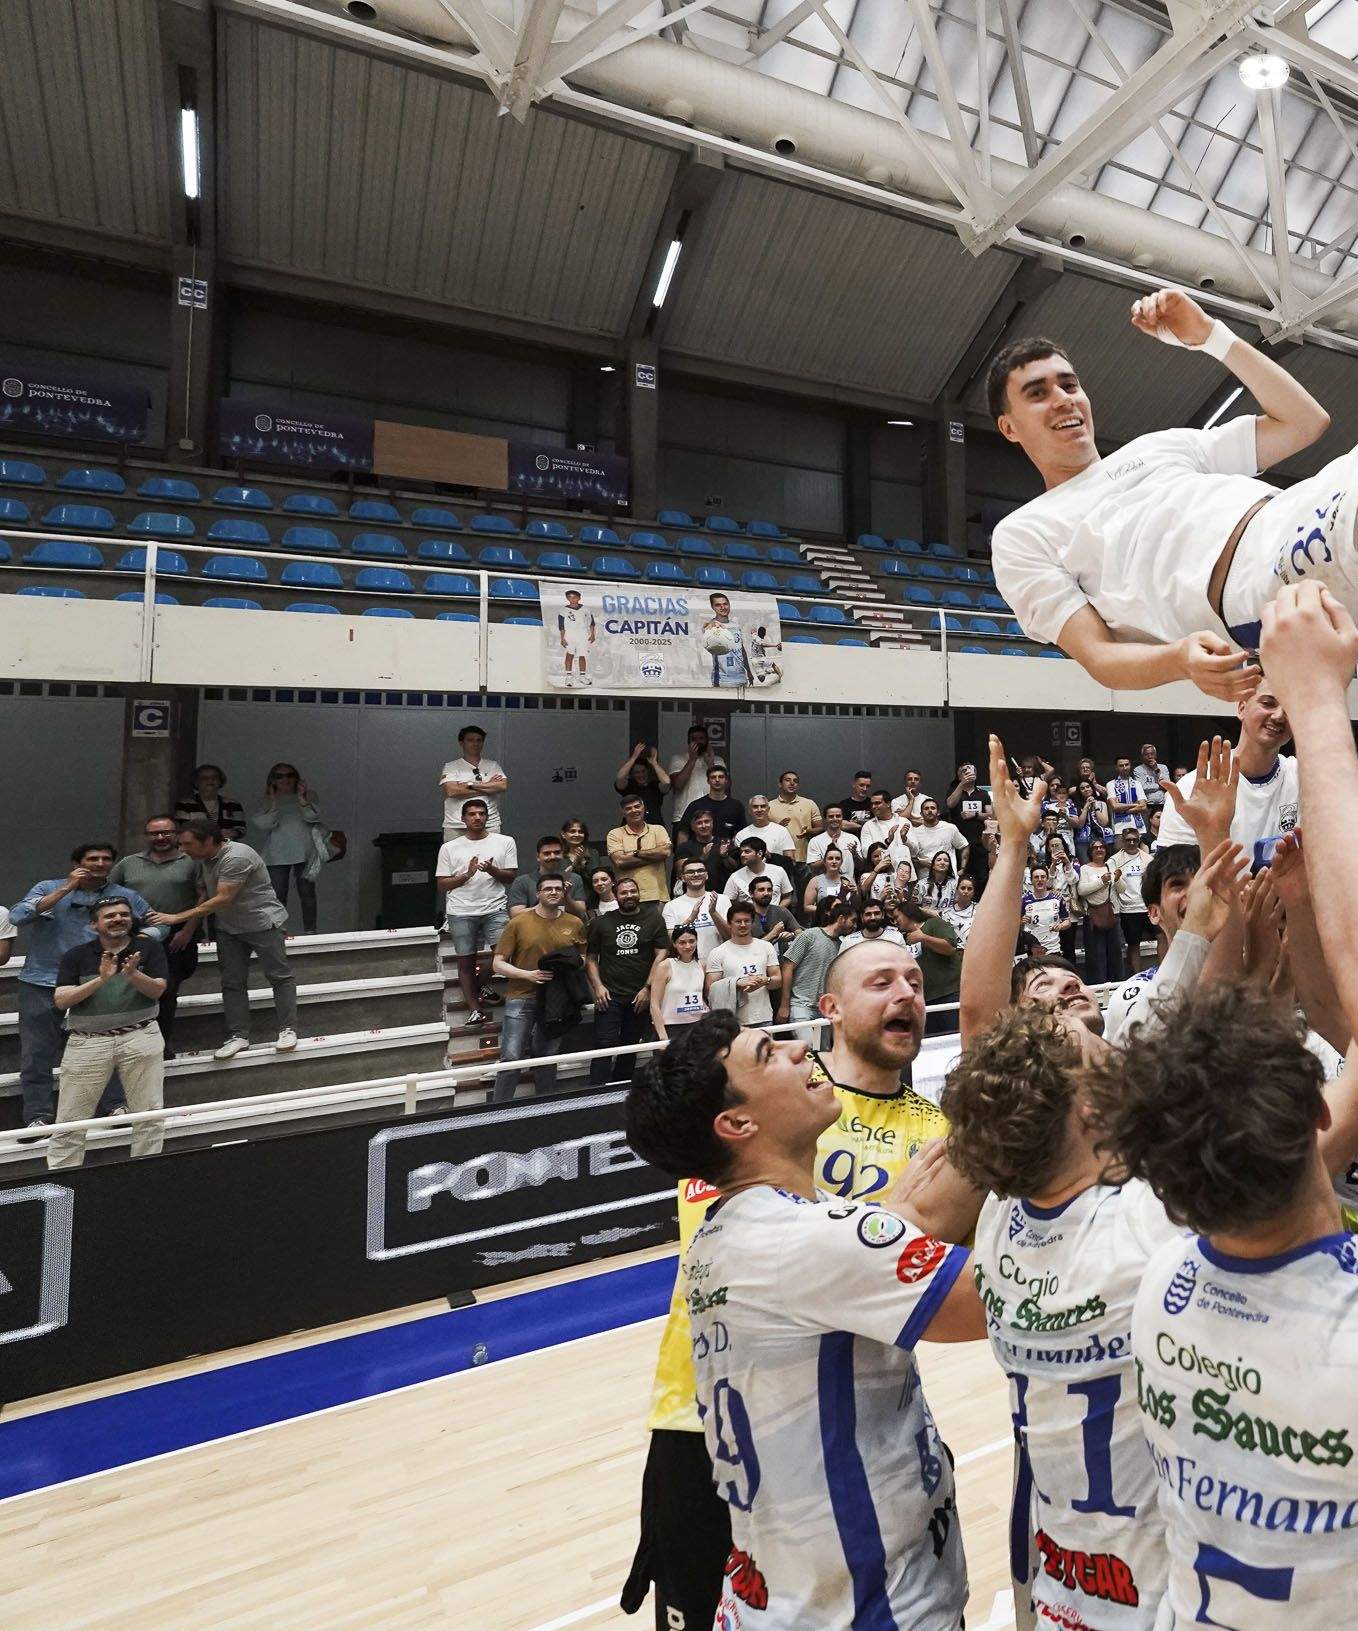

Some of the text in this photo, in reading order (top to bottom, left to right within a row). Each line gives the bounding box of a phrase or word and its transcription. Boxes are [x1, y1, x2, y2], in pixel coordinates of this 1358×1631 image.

[28, 389, 112, 407] PONTEVEDRA
[276, 424, 344, 440] PONTEVEDRA
[552, 463, 606, 476] PONTEVEDRA
[601, 593, 690, 618] GRACIAS
[604, 617, 690, 637] CAPITÁN
[629, 637, 673, 647] 2000-2025
[138, 708, 163, 727] C
[707, 724, 722, 739] C
[1068, 727, 1078, 740] C
[967, 802, 978, 810] 13
[743, 964, 757, 975] 13
[684, 995, 699, 1005] 13
[851, 1116, 895, 1145] ence
[822, 1149, 889, 1200] 92
[1202, 1281, 1248, 1304] Concello
[1197, 1297, 1270, 1323] de Pontevedra
[1156, 1332, 1261, 1395] Colegio
[1192, 1388, 1354, 1467] Sauces
